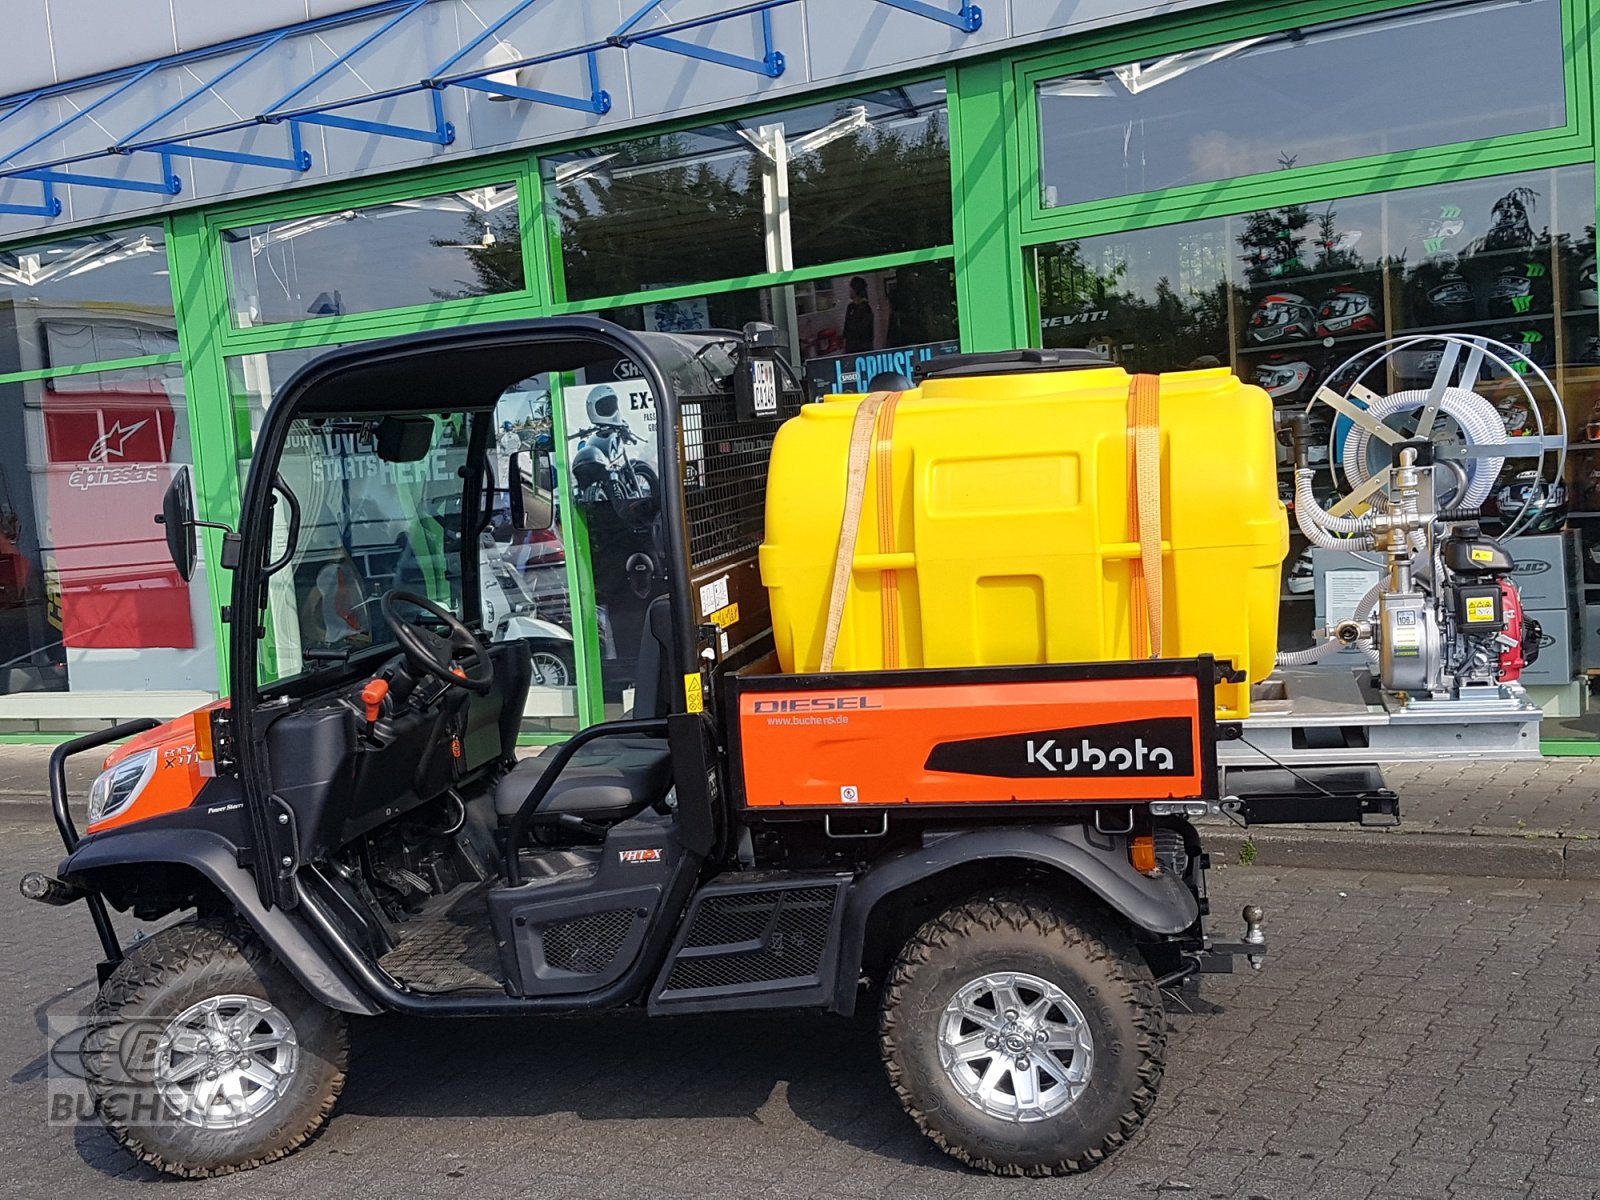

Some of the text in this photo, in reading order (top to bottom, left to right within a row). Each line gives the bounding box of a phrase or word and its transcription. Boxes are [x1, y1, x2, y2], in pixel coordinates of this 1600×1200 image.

[629, 391, 657, 411] EX-
[69, 464, 157, 490] alpinestars
[312, 455, 378, 483] STARTS
[754, 696, 882, 714] DIESEL
[767, 715, 849, 726] www.buchens.de
[1026, 738, 1174, 772] Kubota
